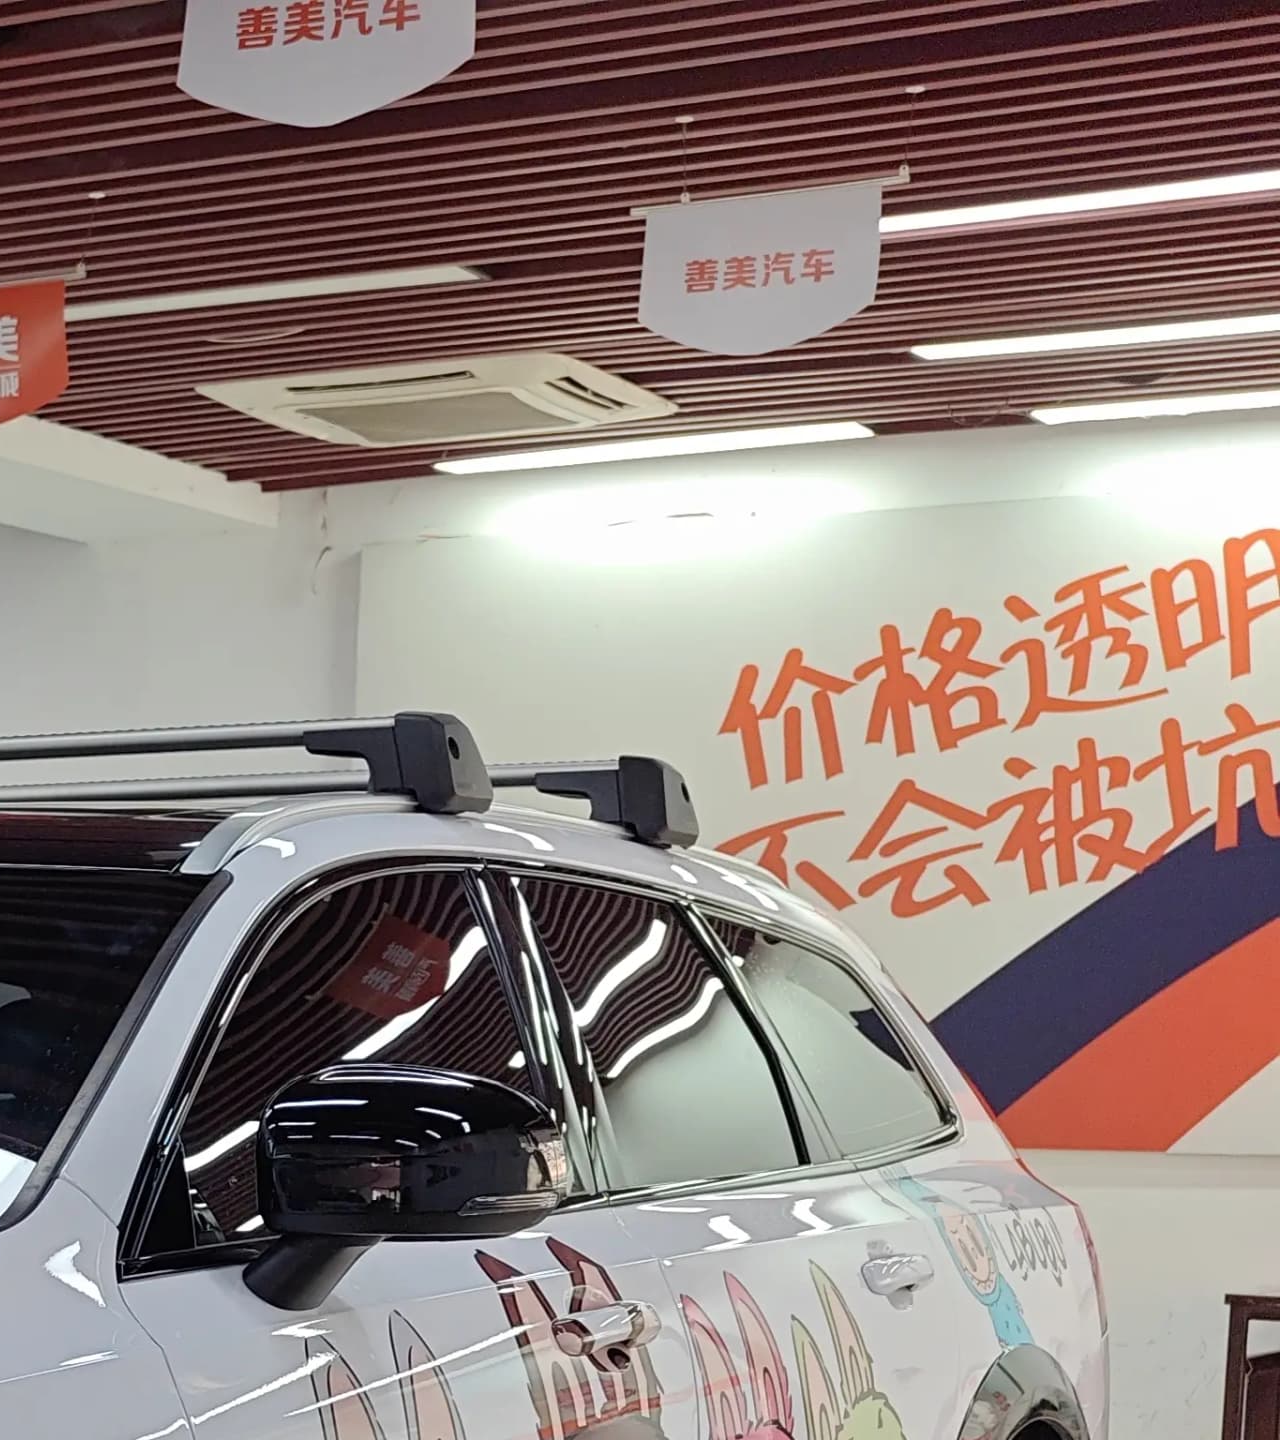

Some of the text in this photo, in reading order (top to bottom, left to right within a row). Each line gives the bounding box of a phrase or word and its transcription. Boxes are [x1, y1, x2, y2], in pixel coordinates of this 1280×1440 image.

[236, 0, 421, 50] 善美汽车
[684, 249, 835, 293] 善美汽车
[717, 528, 1280, 789] 价格透明
[715, 704, 1280, 917] 不会被坑
